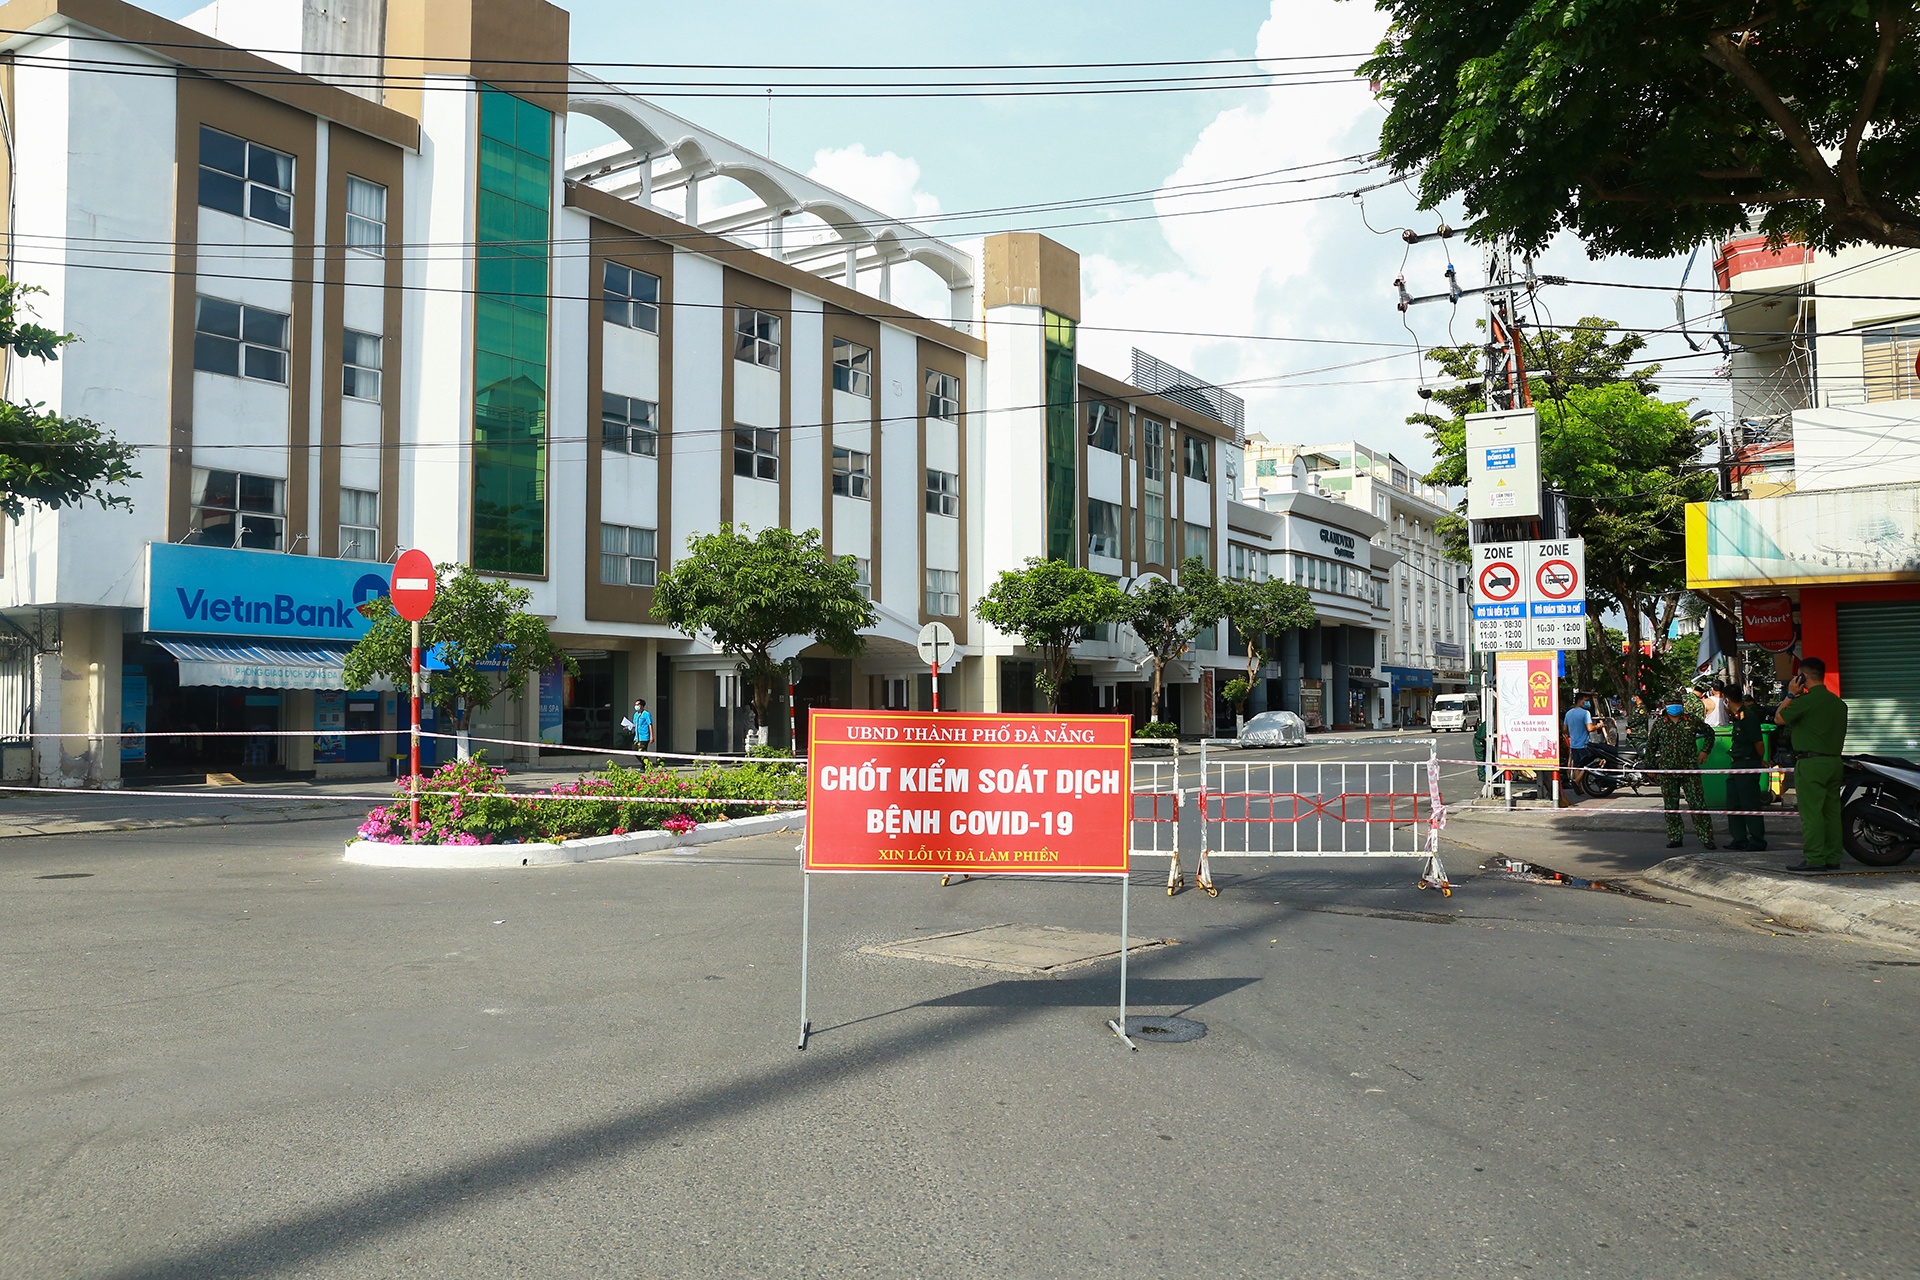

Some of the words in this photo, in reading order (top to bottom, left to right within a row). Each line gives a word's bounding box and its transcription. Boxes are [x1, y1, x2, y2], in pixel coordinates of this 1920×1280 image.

[1484, 547, 1513, 559] ZONE
[1539, 544, 1569, 556] ZONE
[177, 587, 353, 628] VietinBank
[1480, 621, 1497, 629] 06:30
[1504, 620, 1522, 628] 08:30
[1563, 623, 1580, 631] 12:00
[1480, 631, 1497, 639] 11:00
[1505, 630, 1522, 638] 12:00
[1481, 641, 1497, 649] 16:00
[1537, 637, 1555, 645] 16:30
[1563, 637, 1580, 645] 19:00
[264, 669, 283, 677] GIAO
[285, 670, 302, 679] DỊCH
[548, 704, 559, 712] SPA
[1533, 696, 1549, 708] XV
[847, 726, 898, 740] UBND
[903, 722, 967, 742] THÀNH
[972, 723, 1011, 742] PHỐ
[1014, 724, 1040, 743] ĐÀ
[1044, 722, 1094, 744] NẴNG
[820, 758, 891, 792] CHỐT
[899, 758, 968, 793] KIỂM
[978, 764, 1049, 794] SOÁT
[1056, 769, 1119, 800] DỊCH
[866, 804, 940, 840] BỆNH
[949, 810, 1073, 836] COVID-19
[878, 850, 904, 861] XIN
[909, 844, 933, 861] LỖI
[937, 848, 952, 861] VÌ
[956, 848, 975, 862] ĐÃ
[979, 847, 1011, 862] LÀM
[1014, 846, 1059, 862] PHIỀN
